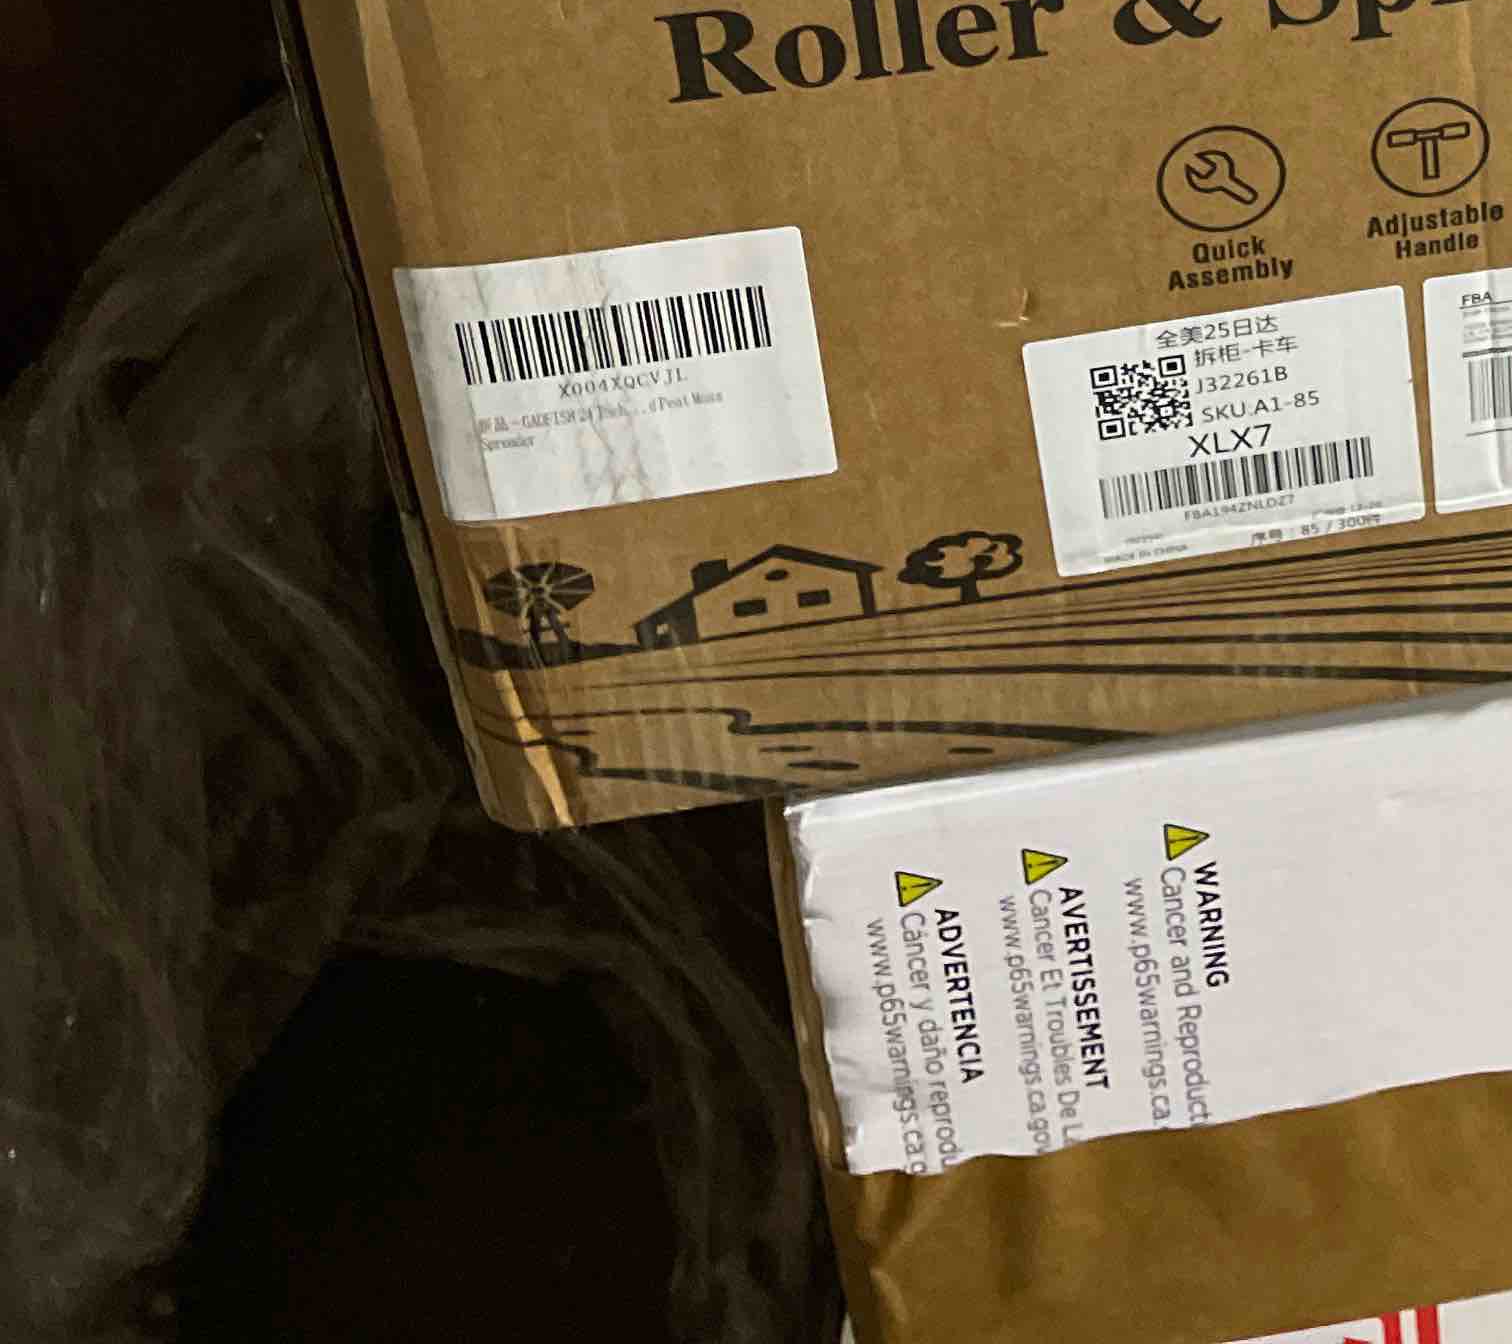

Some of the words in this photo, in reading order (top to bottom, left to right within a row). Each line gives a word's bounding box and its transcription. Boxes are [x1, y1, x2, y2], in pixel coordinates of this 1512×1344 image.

[1366, 200, 1506, 240] Adjustable
[1192, 235, 1267, 265] Quick
[1395, 230, 1481, 261] Handle
[1167, 256, 1295, 293] Assembly
[1461, 291, 1493, 306] FBA
[1156, 313, 1280, 349] 全美25日达
[1193, 335, 1299, 368] 拆柜-卡车
[1195, 365, 1289, 395] J32261B
[1187, 423, 1272, 458] XLX7
[1159, 866, 1190, 948] Cancer
[1194, 861, 1230, 989] WARNING
[1028, 889, 1057, 963] Cancer
[899, 911, 932, 993] Cáncer
[934, 908, 985, 1084] ADVERTENCIA
[1039, 968, 1065, 993] Et
[1059, 887, 1110, 1090] AVERTISSEMENT
[1168, 960, 1197, 998] and
[908, 997, 934, 1013] y
[1122, 878, 1172, 1130] www.p65warnings.ca.
[918, 1018, 945, 1077] daño
[1046, 998, 1076, 1088] Troubles
[1057, 1090, 1081, 1118] De
